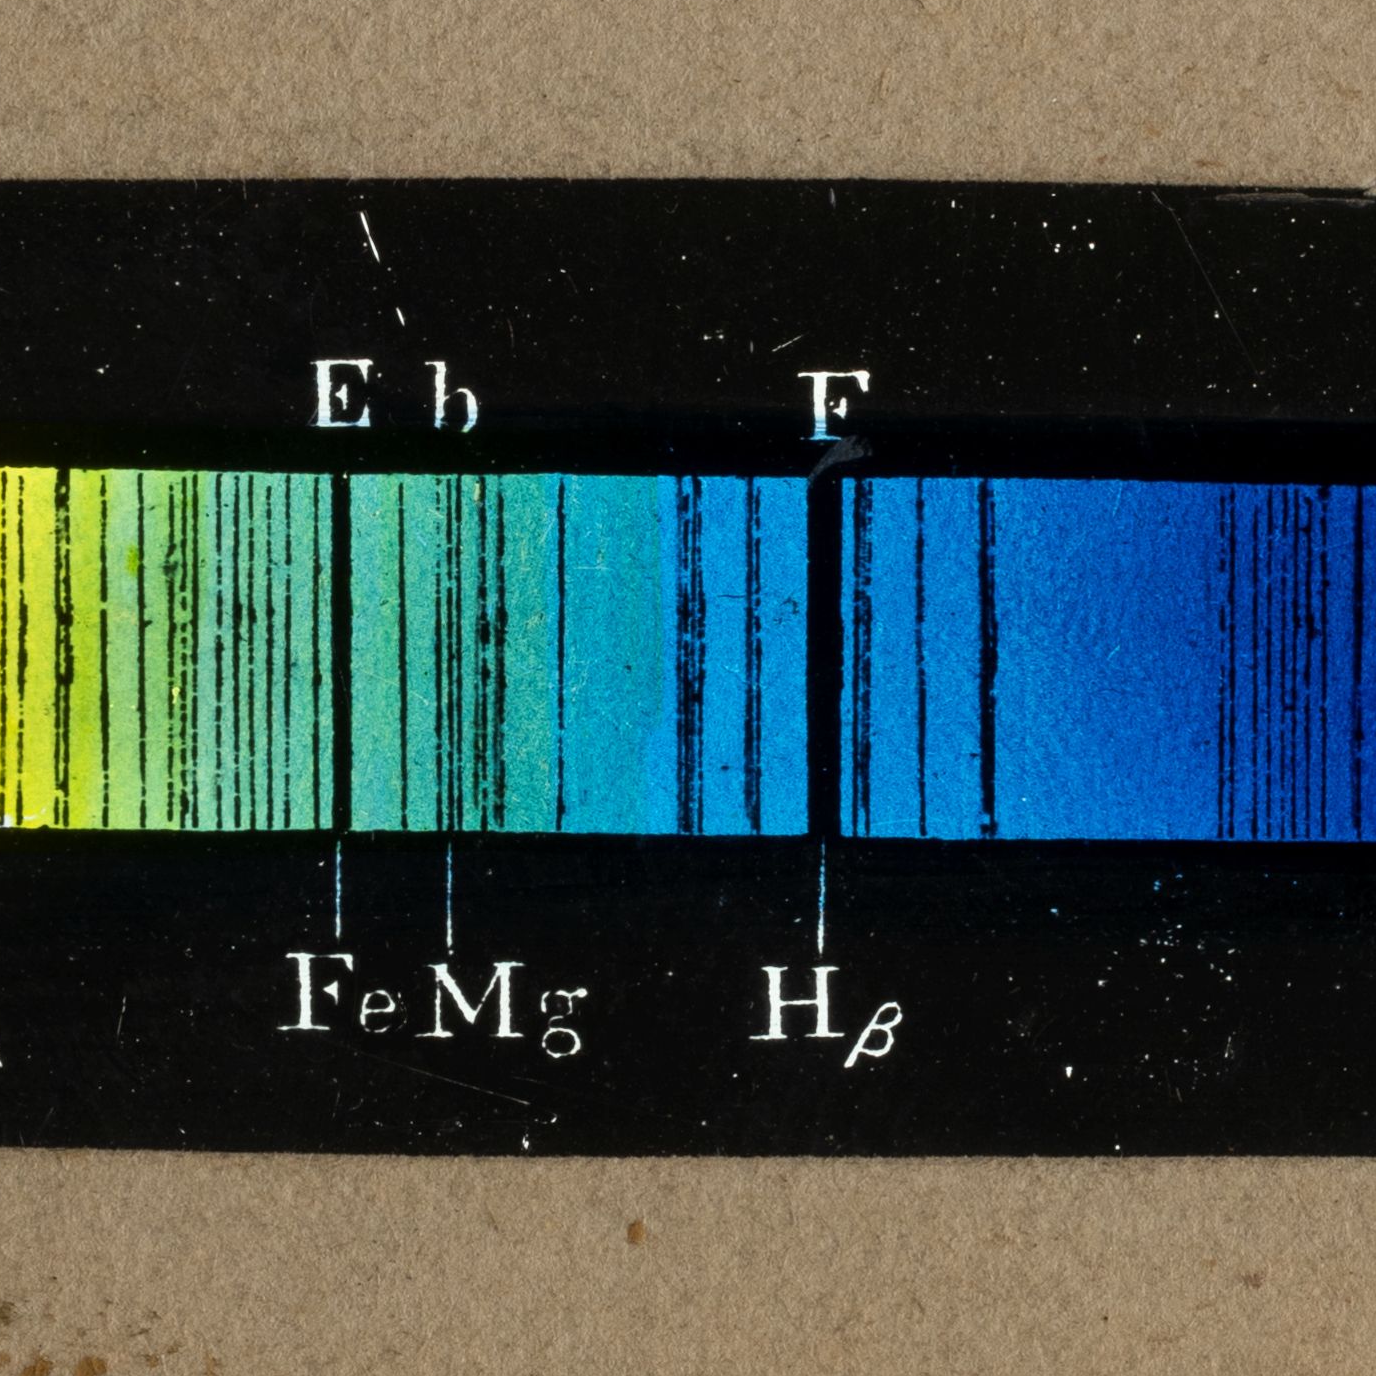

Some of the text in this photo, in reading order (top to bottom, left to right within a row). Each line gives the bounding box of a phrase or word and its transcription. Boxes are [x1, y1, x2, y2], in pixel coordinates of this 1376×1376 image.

[310, 357, 375, 429] E
[425, 359, 480, 433] b
[796, 368, 872, 442] F
[278, 951, 398, 1033] Fe
[415, 960, 589, 1057] Mg
